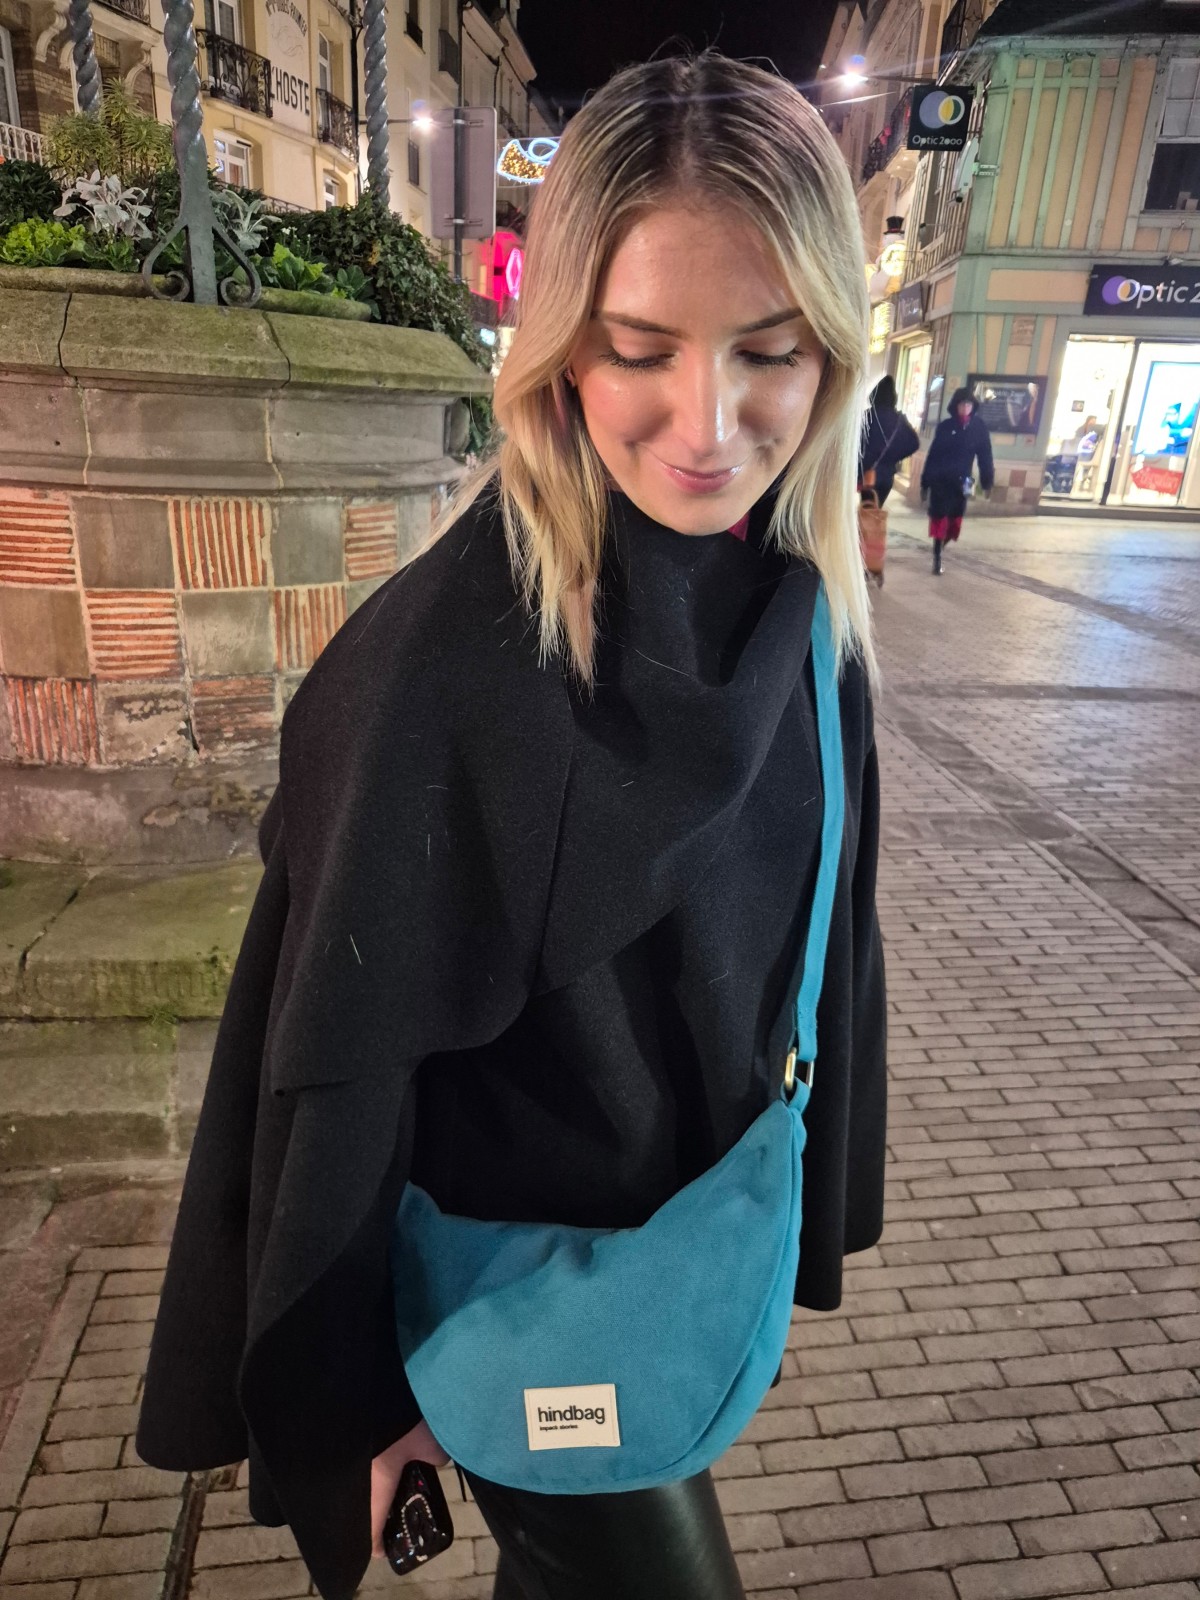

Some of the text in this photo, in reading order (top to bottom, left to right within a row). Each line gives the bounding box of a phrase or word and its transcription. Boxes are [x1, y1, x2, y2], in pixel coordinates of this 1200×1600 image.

[912, 135, 963, 146] Optic 2000
[1117, 278, 1189, 310] Optic
[537, 1405, 605, 1425] hindbag
